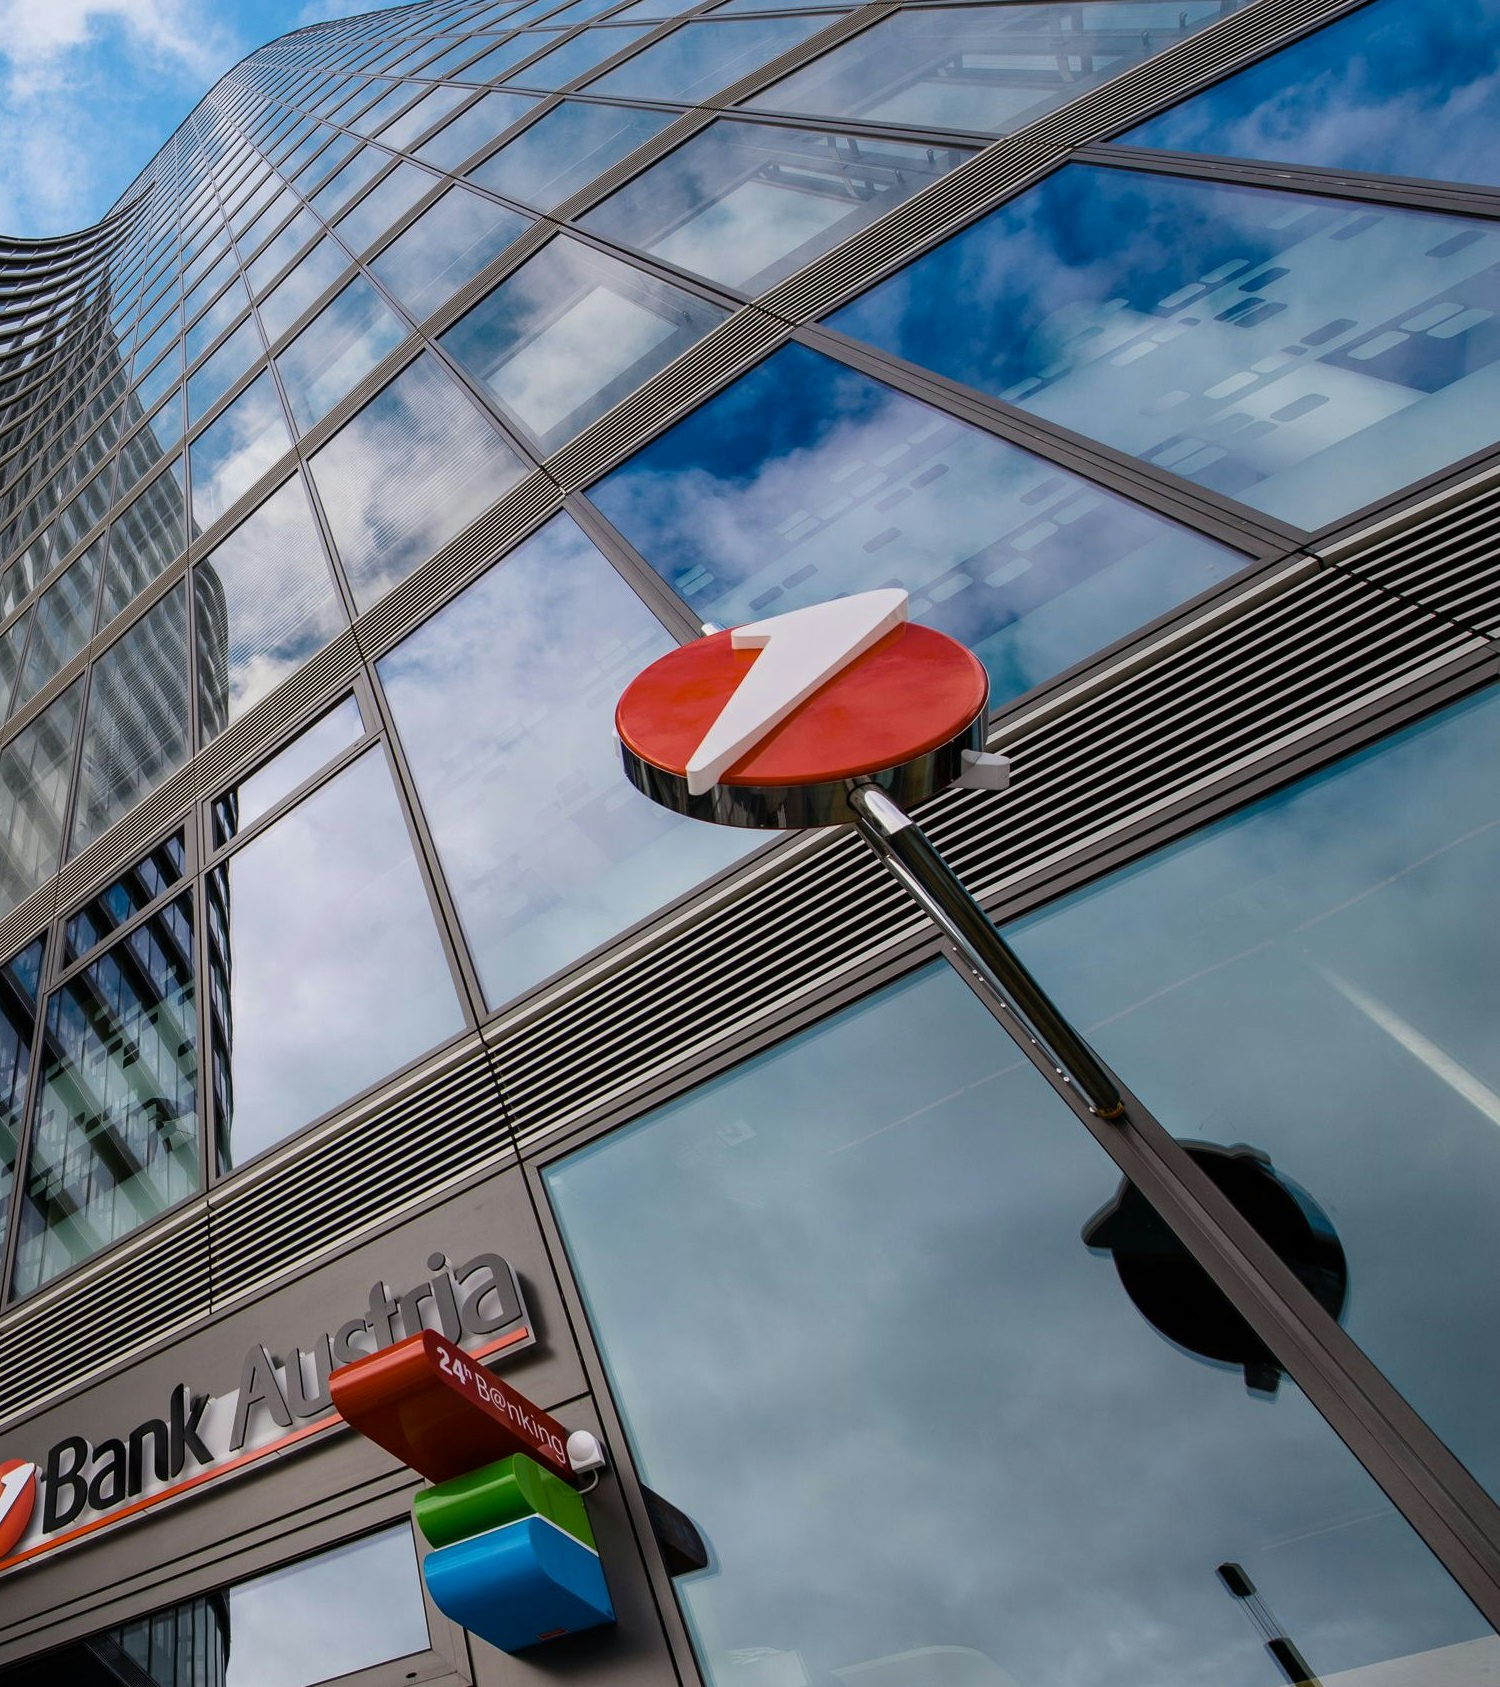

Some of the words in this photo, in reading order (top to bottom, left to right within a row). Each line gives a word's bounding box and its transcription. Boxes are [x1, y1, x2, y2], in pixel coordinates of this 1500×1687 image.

[41, 1383, 215, 1535] Bank
[436, 1346, 473, 1385] 24h
[474, 1372, 567, 1465] B@nking
